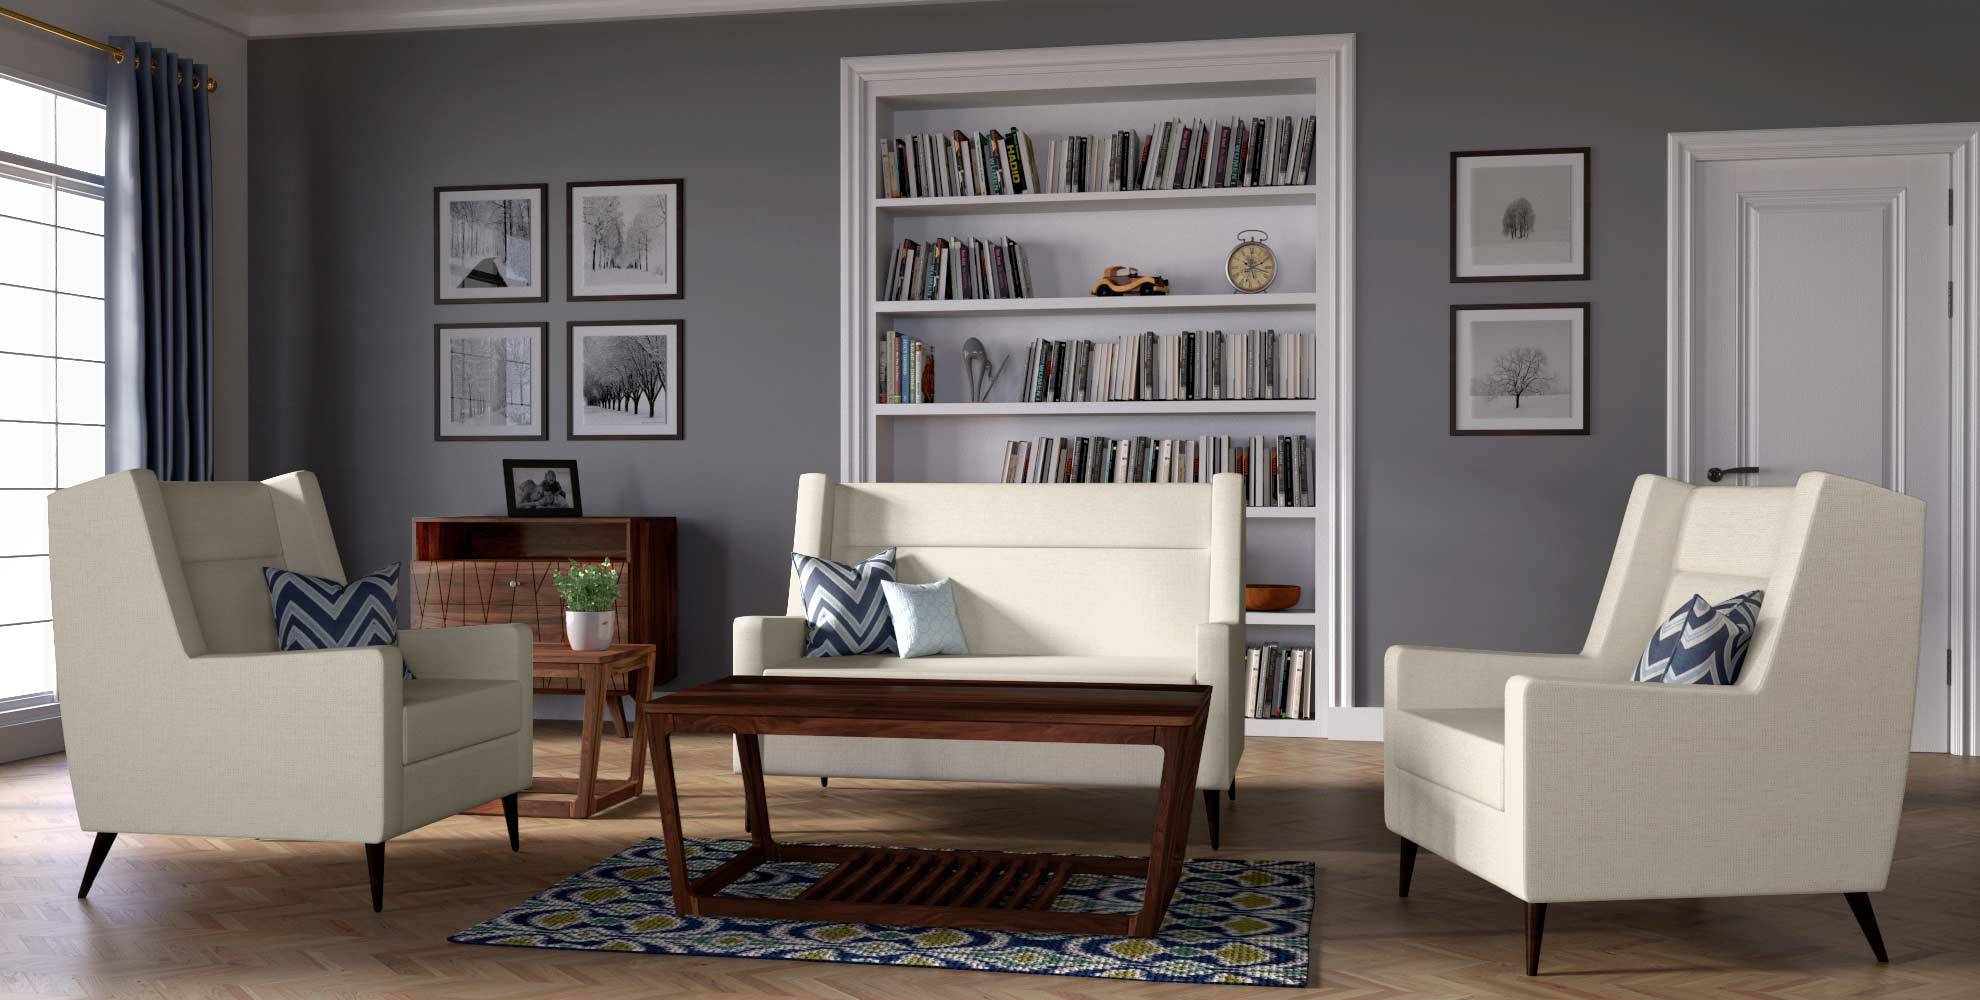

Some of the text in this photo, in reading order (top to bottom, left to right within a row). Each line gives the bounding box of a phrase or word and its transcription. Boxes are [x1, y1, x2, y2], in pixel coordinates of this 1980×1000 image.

[1007, 144, 1020, 183] HADID
[1231, 143, 1240, 180] WOMEN
[1036, 364, 1044, 396] WOMEN
